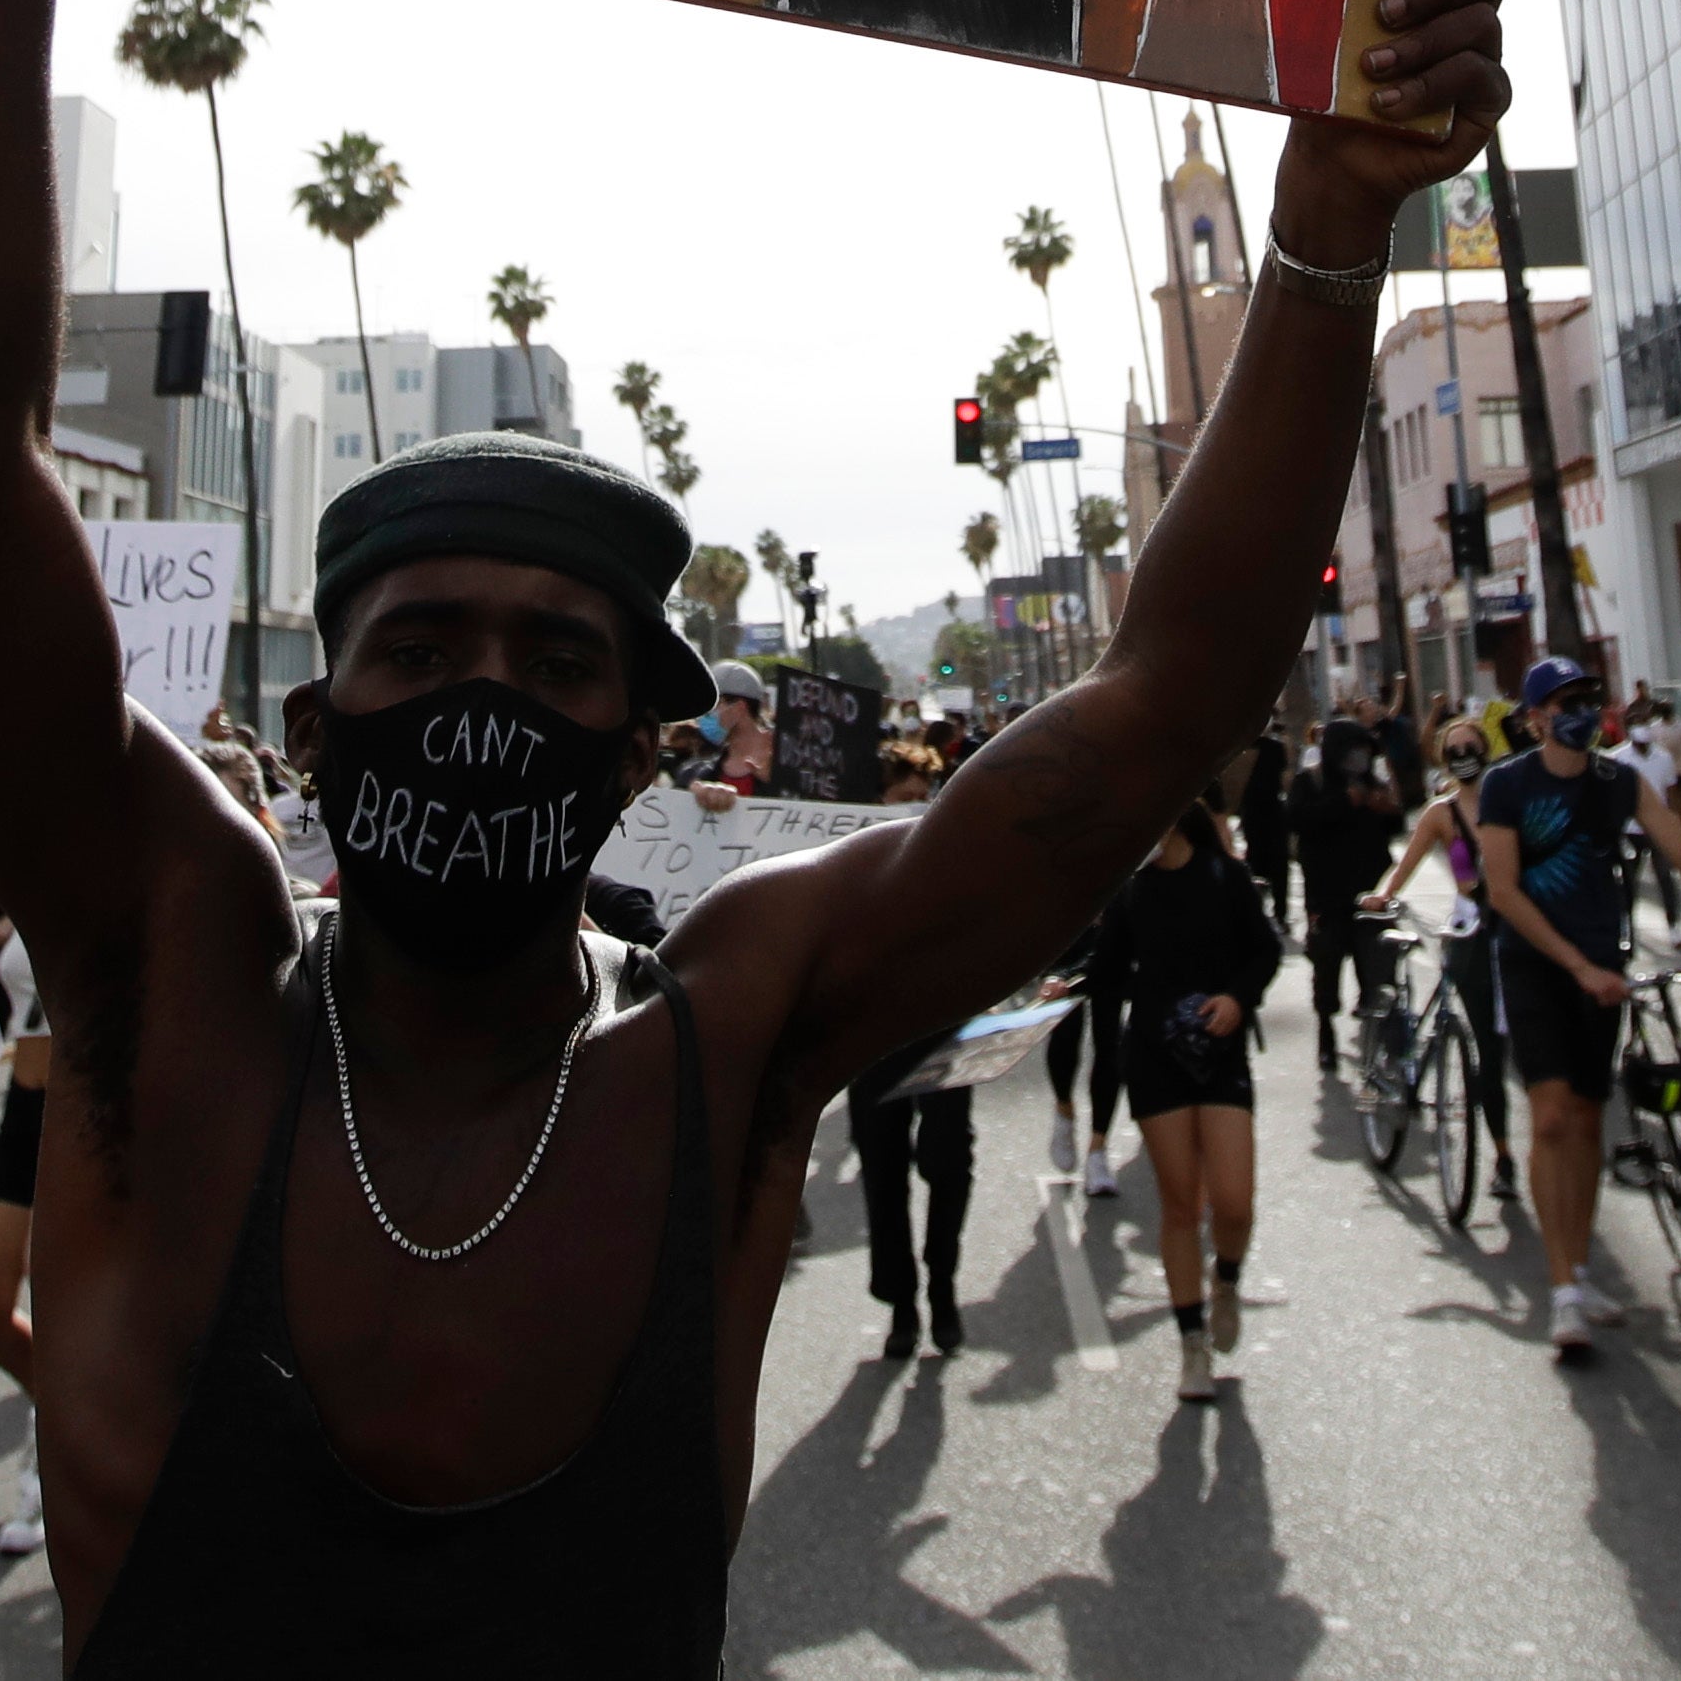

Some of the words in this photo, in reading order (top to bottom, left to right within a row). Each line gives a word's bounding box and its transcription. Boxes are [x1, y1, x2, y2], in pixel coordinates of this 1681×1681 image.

[787, 677, 859, 724] DEFUND
[422, 710, 547, 778] CANT
[799, 769, 839, 798] THE
[345, 769, 583, 884] BREATHE
[696, 814, 718, 836] A
[746, 806, 894, 838] THREA
[636, 837, 693, 874] TO
